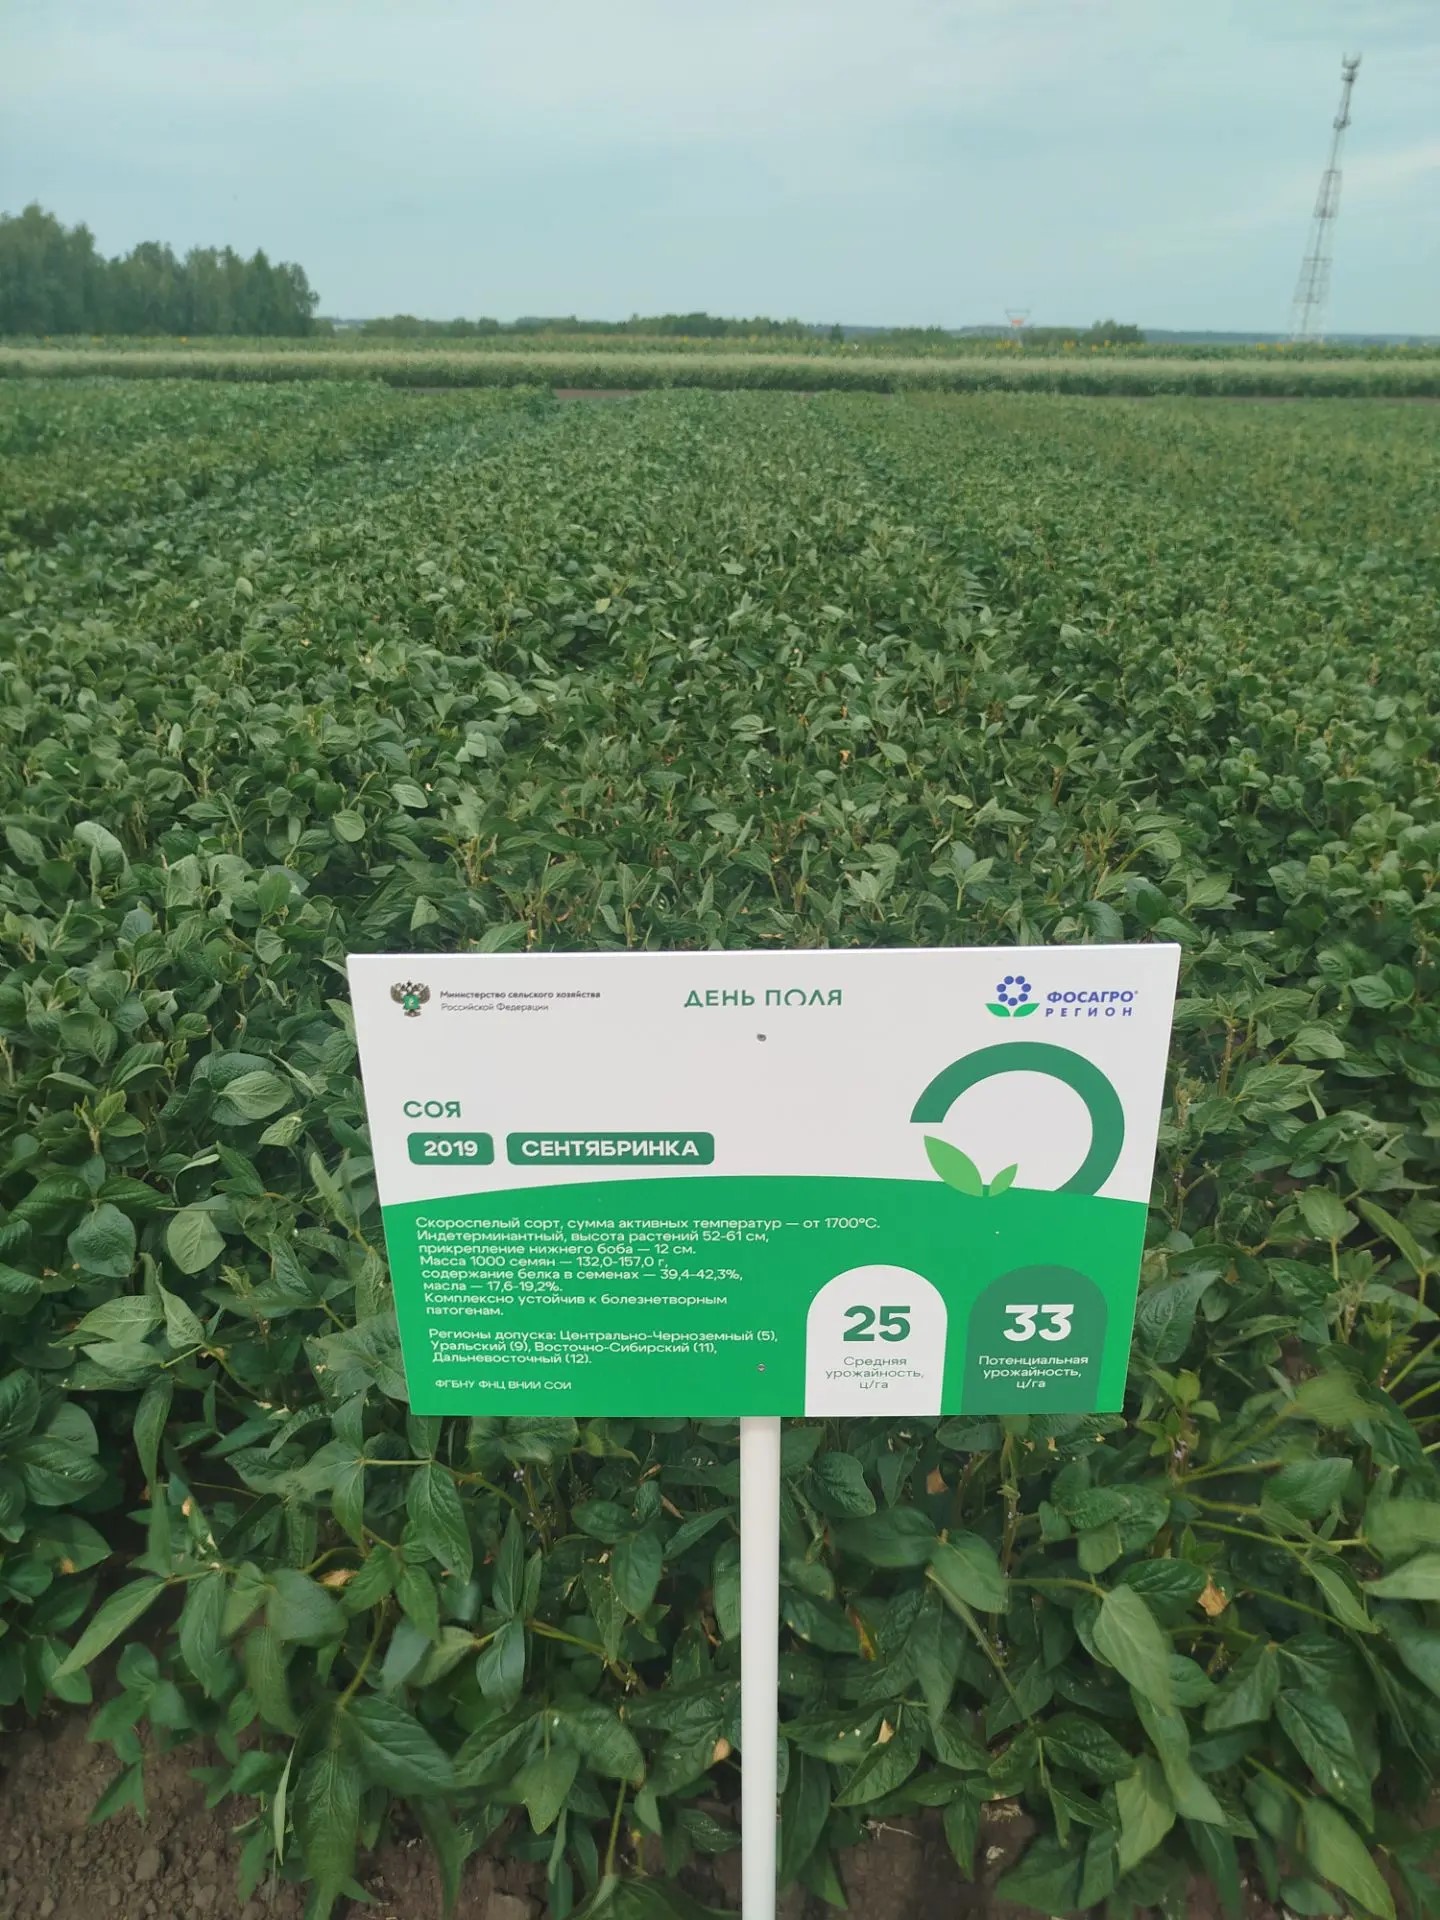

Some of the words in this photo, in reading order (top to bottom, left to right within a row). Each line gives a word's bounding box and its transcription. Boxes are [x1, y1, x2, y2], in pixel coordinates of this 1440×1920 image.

[684, 990, 755, 1007] ДЕНЬ
[765, 990, 842, 1006] ПОЛЯ
[441, 1003, 494, 1011] Российской
[496, 1003, 549, 1012] Федерации
[1045, 1007, 1133, 1017] РЕГИОН
[403, 1101, 461, 1118] СОЯ
[424, 1140, 478, 1157] 2019
[522, 1140, 699, 1157] СЕНТЯБРИНКА
[416, 1217, 520, 1230] Скороспелый
[524, 1220, 563, 1230] сорт,
[568, 1220, 615, 1230] сумма
[619, 1220, 688, 1228] активных
[693, 1219, 781, 1230] температур
[803, 1220, 818, 1228] от
[417, 1230, 567, 1242] Индетерминантный,
[572, 1233, 624, 1241] высота
[629, 1230, 698, 1243] растений
[703, 1232, 742, 1241] 52-61
[746, 1233, 768, 1243] см,
[419, 1245, 525, 1255] прикрепление
[529, 1246, 593, 1254] нижнего
[598, 1244, 633, 1254] боба
[655, 1244, 668, 1254] 12
[673, 1246, 695, 1254] см.
[420, 1256, 466, 1266] Масса
[470, 1257, 505, 1266] 1000
[510, 1258, 555, 1266] семян
[577, 1257, 654, 1268] 132,0-157,0
[658, 1259, 668, 1268] г,
[422, 1270, 513, 1281] содержание
[518, 1269, 560, 1279] белка
[661, 1270, 742, 1281] 39,4-42,3%,
[424, 1283, 466, 1291] масла
[488, 1282, 563, 1293] 17,6-19,2%.
[425, 1294, 514, 1303] Комплексно
[518, 1294, 585, 1305] устойчив
[589, 1296, 596, 1304] к
[601, 1294, 727, 1306] болезнетворным
[426, 1307, 504, 1316] патогенам.
[843, 1305, 911, 1342] 25
[1003, 1304, 1074, 1342] 33
[429, 1329, 491, 1340] Регионы
[495, 1331, 556, 1342] допуска:
[560, 1331, 753, 1342] Центрально-Черноземный
[757, 1331, 777, 1342] (5),
[431, 1341, 506, 1352] Уральский
[510, 1342, 531, 1352] (9),
[535, 1342, 689, 1354] Восточно-Сибирский
[694, 1343, 717, 1354] (11),
[433, 1353, 561, 1364] Дальневосточный
[565, 1354, 592, 1364] (12).
[843, 1357, 907, 1367] Средняя
[979, 1356, 1088, 1366] Потенциальная
[825, 1368, 924, 1379] урожайность,
[983, 1367, 1081, 1378] урожайность,
[435, 1380, 474, 1389] ФГБНУ
[479, 1380, 505, 1390] ФНЦ
[508, 1381, 541, 1389] ВНИИ
[544, 1381, 572, 1390] СОИ
[860, 1379, 888, 1389] ц/га
[1016, 1378, 1045, 1389] ц/га
